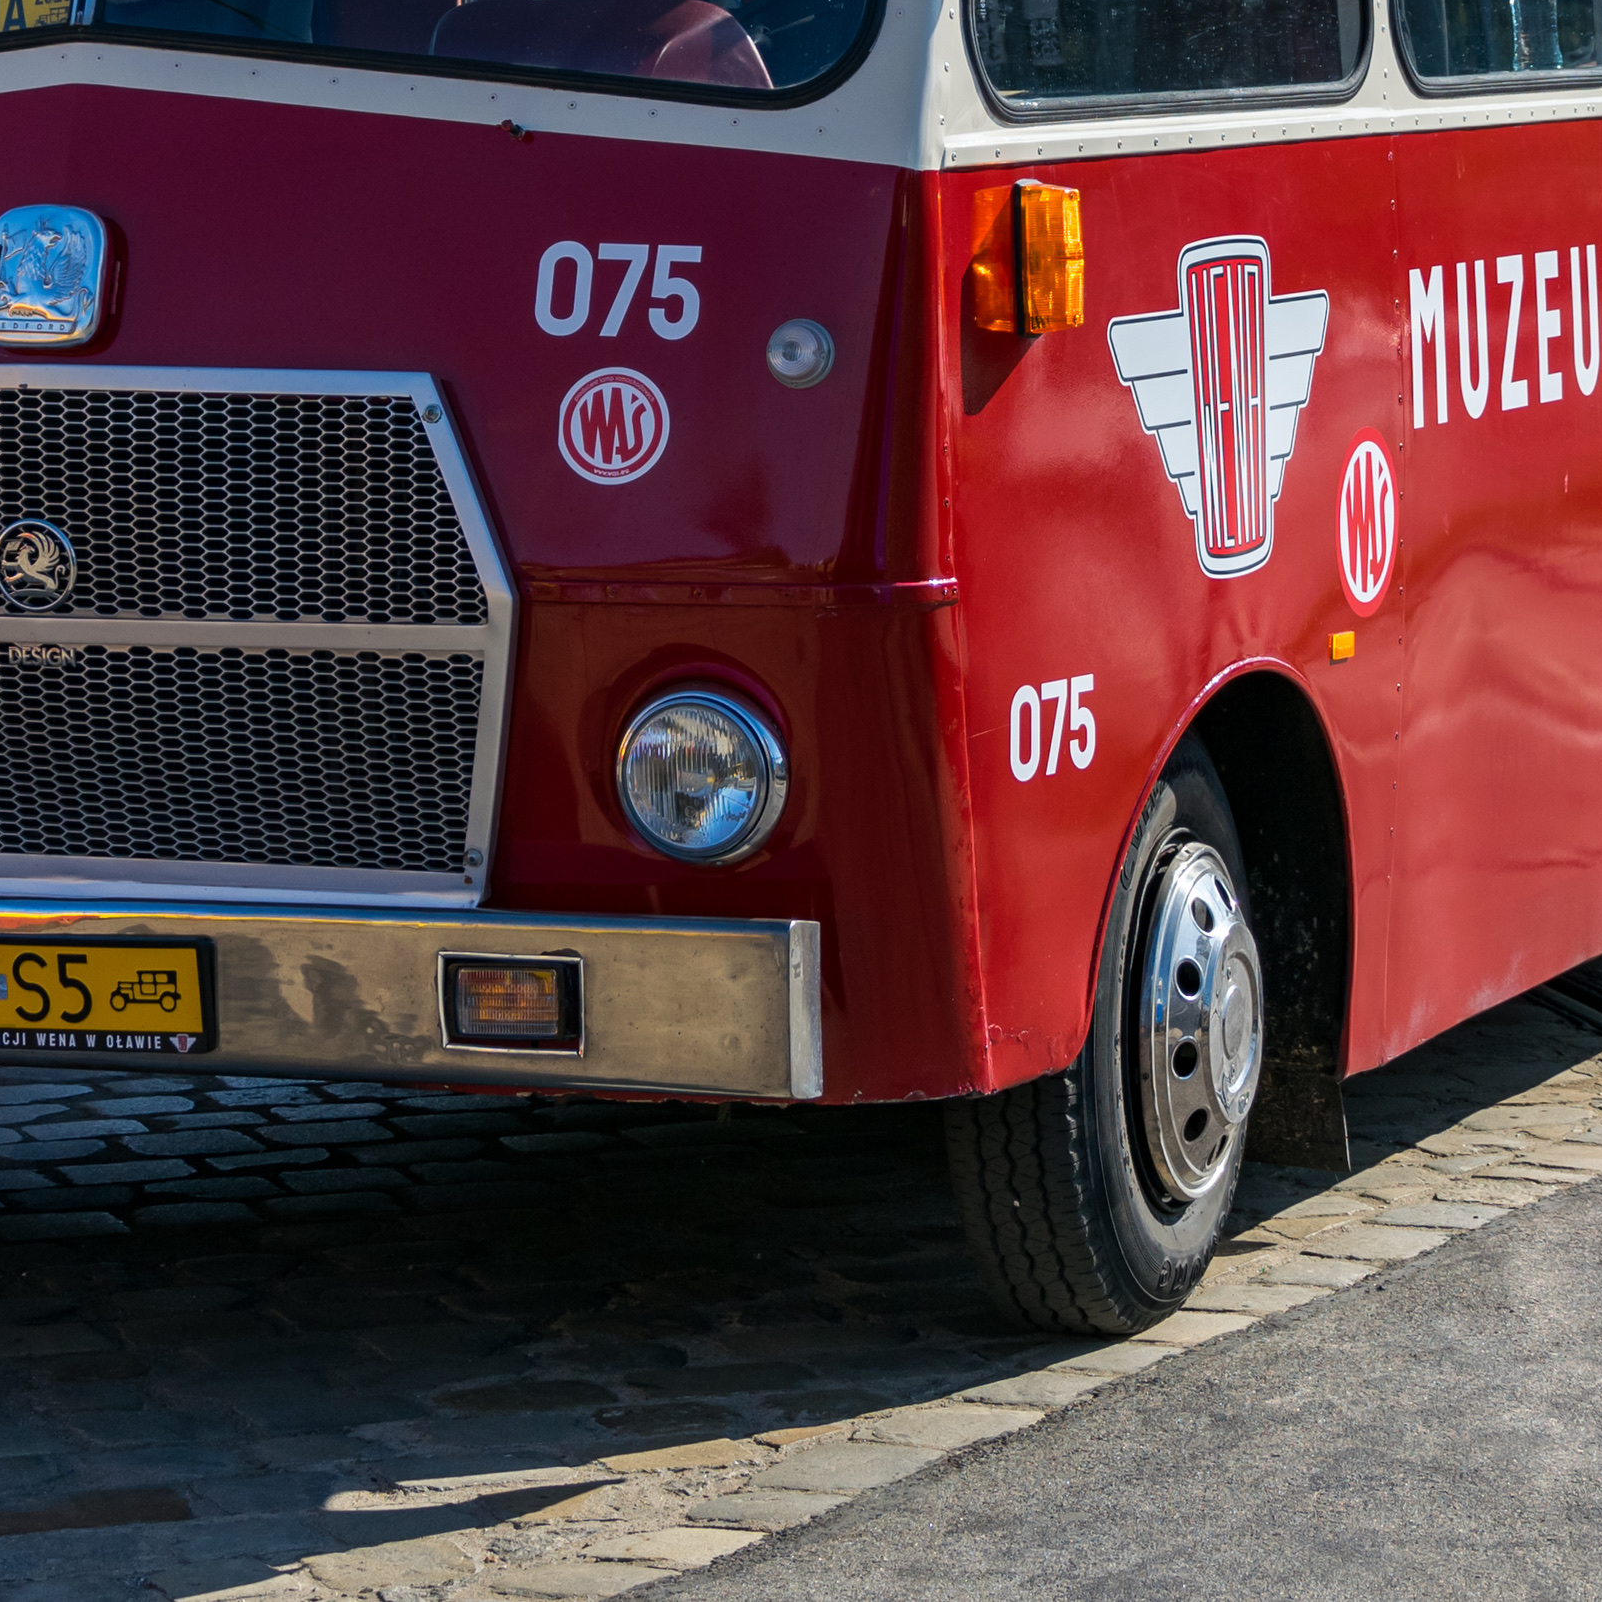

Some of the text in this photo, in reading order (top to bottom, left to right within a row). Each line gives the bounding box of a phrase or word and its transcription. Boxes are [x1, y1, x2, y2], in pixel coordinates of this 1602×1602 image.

[534, 240, 703, 340] 075
[7, 645, 77, 667] DESIGN
[1009, 673, 1096, 783] 075
[12, 951, 93, 1024] S5
[36, 1033, 77, 1048] WENA
[86, 1033, 97, 1048] W
[105, 1033, 162, 1050] OŁAWIE
